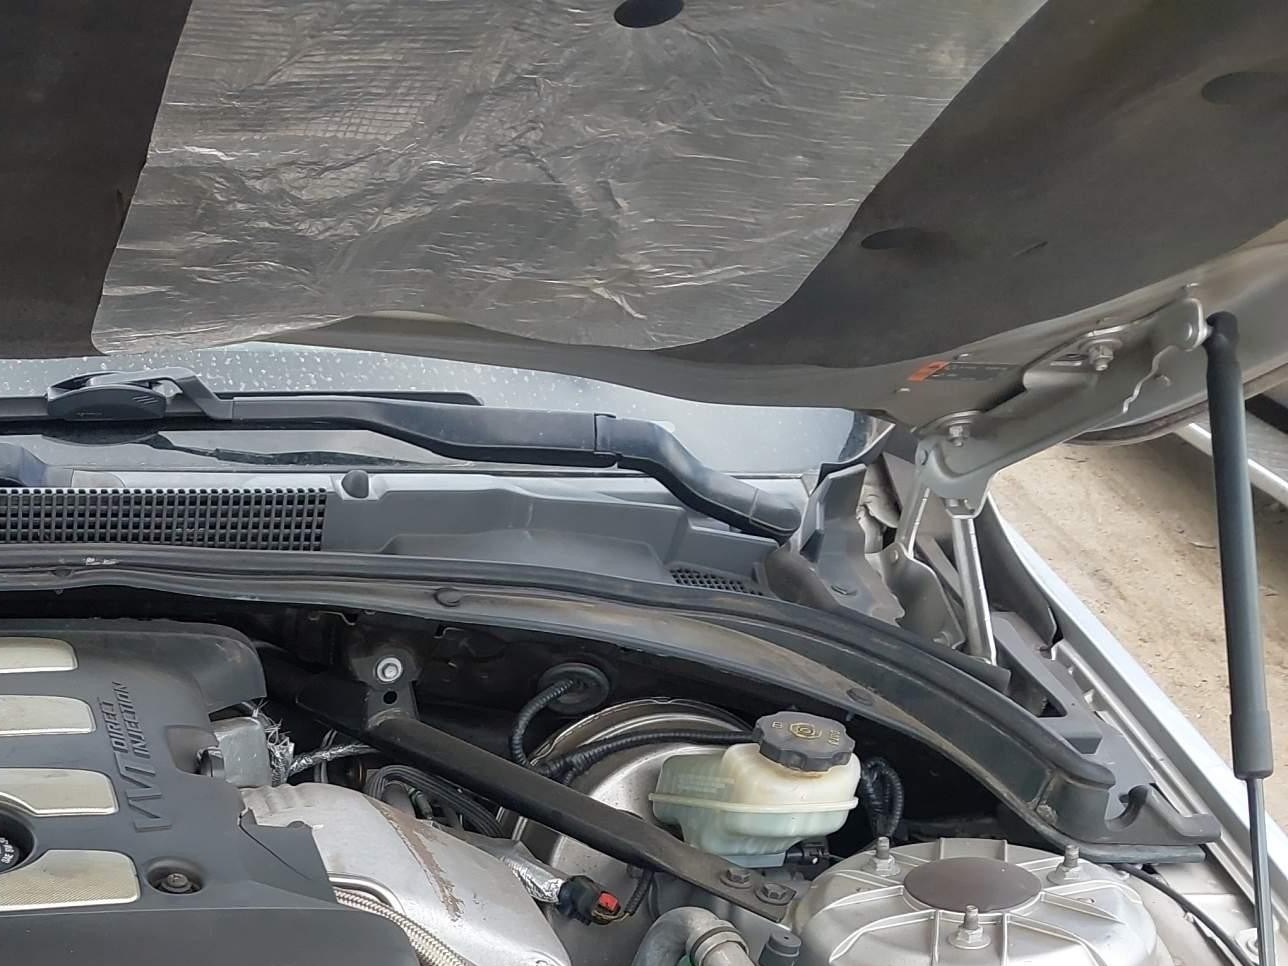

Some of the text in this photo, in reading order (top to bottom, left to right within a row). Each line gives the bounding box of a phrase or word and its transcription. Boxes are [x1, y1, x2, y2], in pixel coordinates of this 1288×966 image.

[97, 697, 129, 754] DIRECT
[112, 681, 151, 759] INJECTION
[112, 750, 172, 833] VVT
